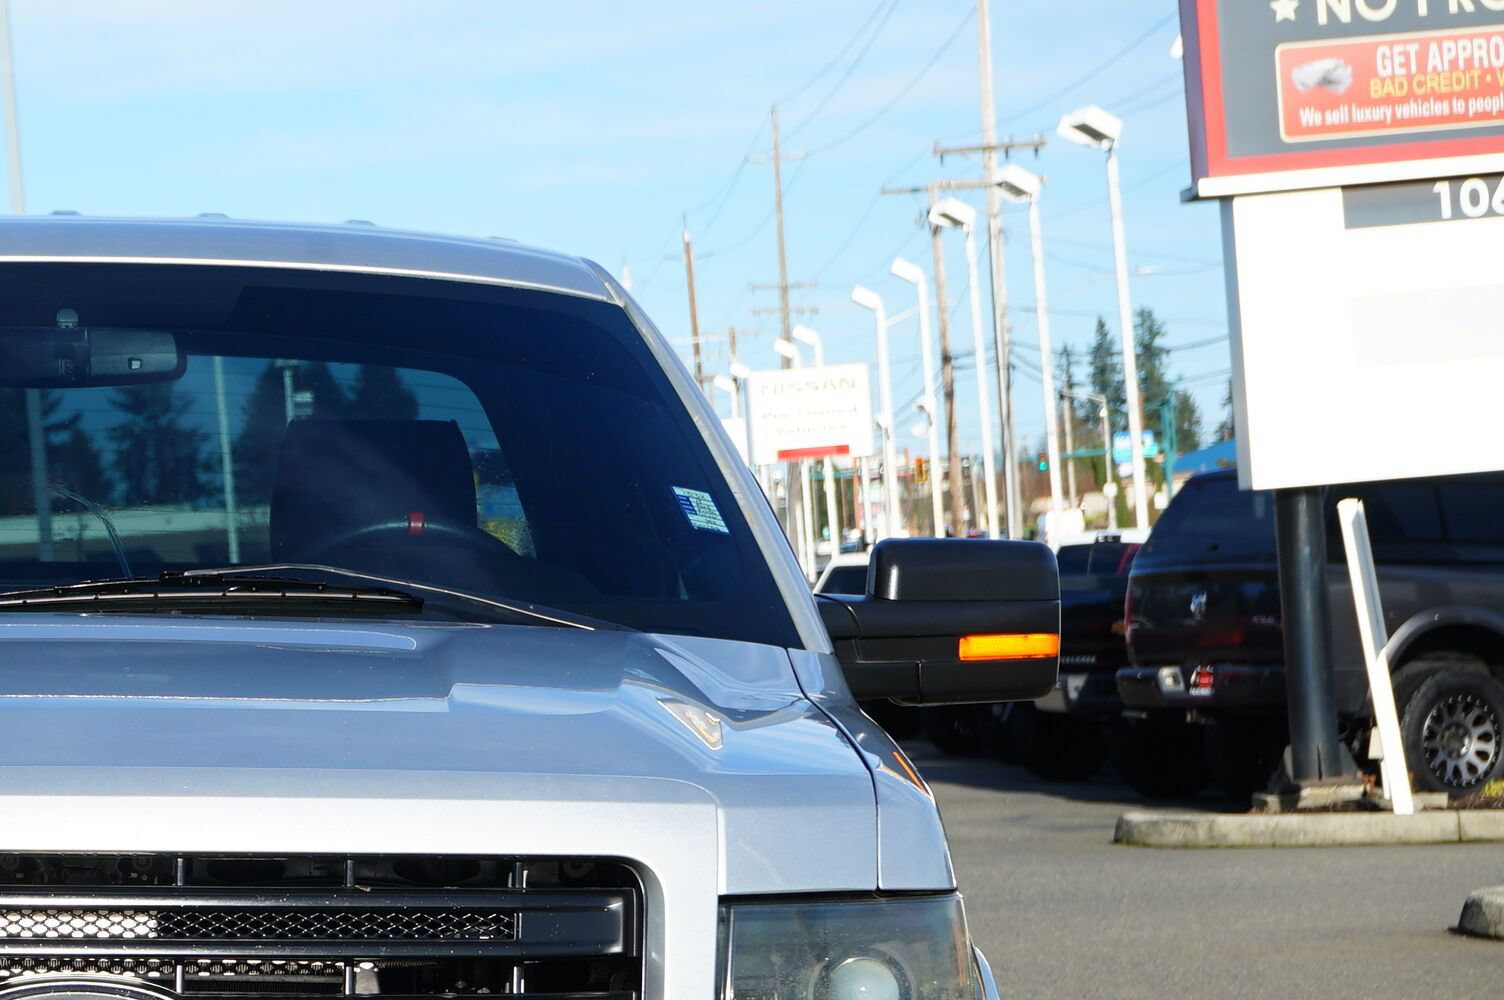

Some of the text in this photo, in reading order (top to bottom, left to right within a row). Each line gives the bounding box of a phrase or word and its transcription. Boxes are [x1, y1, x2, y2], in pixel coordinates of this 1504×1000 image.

[1376, 35, 1504, 77] GET APPRO
[1369, 77, 1408, 99] BAD
[1412, 69, 1481, 95] CREDIT
[1299, 106, 1322, 128] We
[1325, 104, 1347, 124] sell
[1352, 102, 1392, 124] luxury
[1395, 97, 1449, 120] vehicles
[1452, 96, 1466, 114] to
[760, 376, 857, 397] NISSAN
